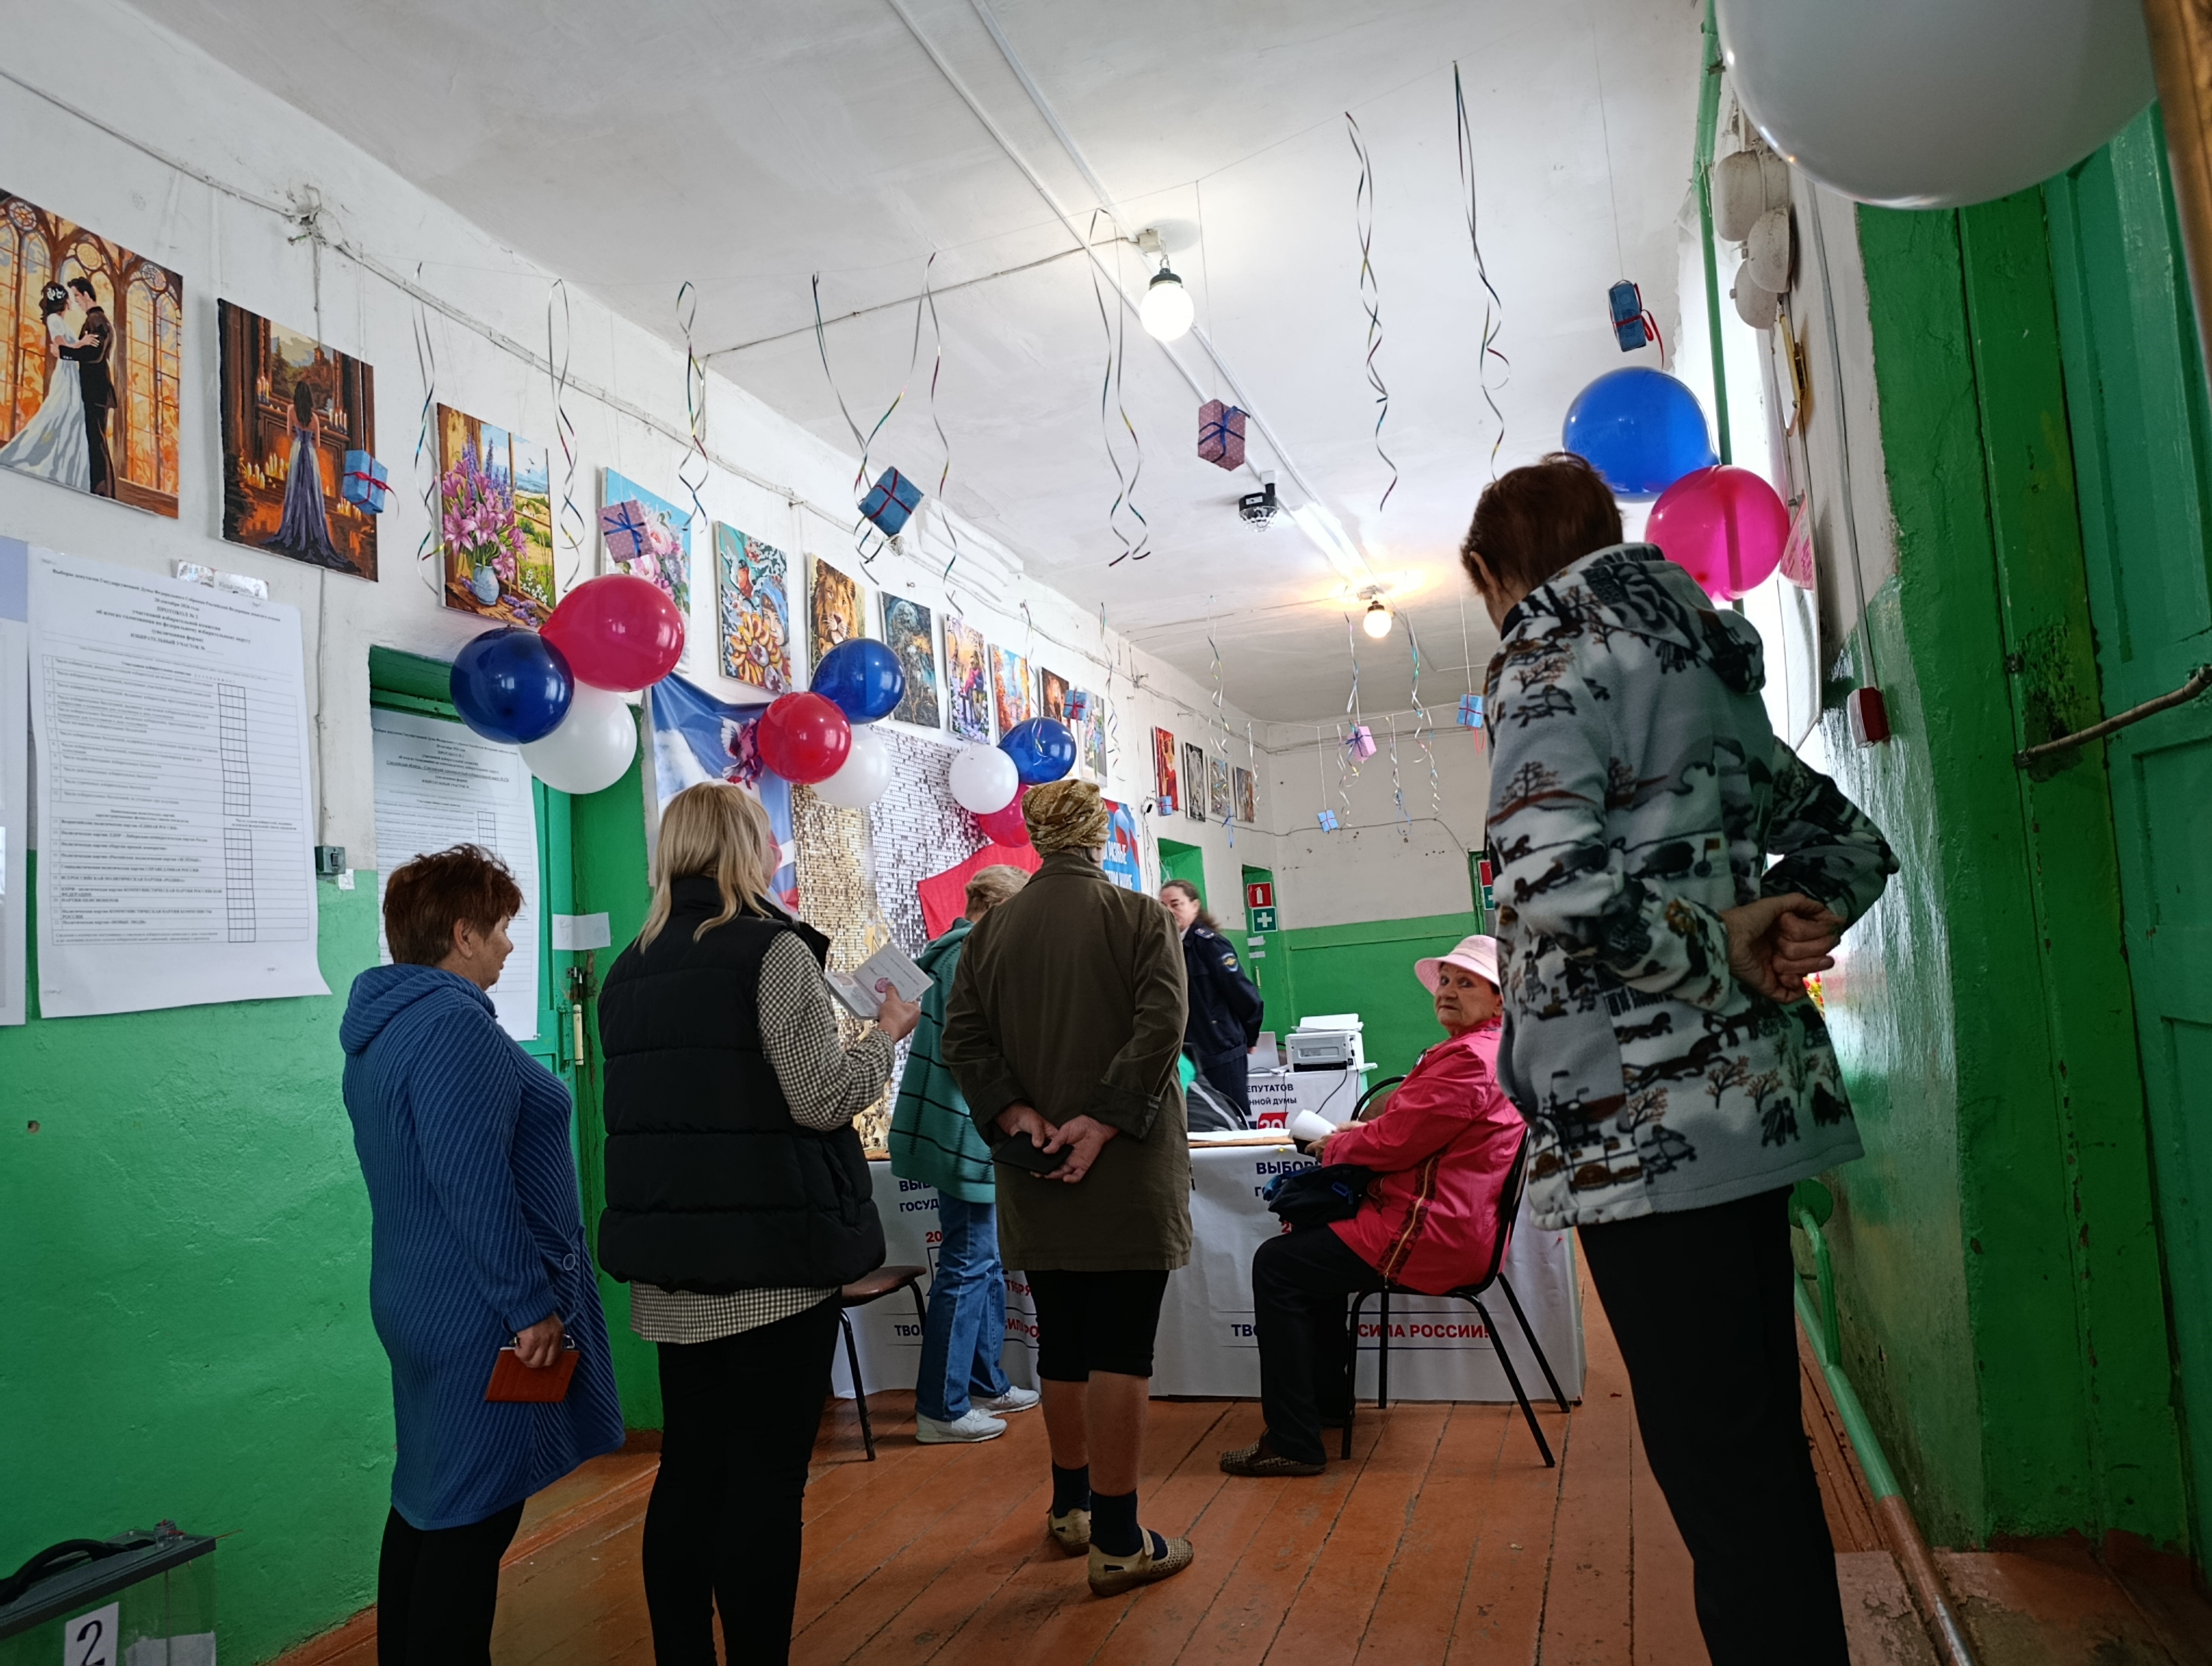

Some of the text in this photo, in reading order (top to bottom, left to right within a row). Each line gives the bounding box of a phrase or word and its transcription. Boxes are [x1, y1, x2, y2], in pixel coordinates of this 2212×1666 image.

[53, 568, 73, 576] Выборы
[75, 574, 99, 582] депутатов
[100, 578, 139, 590] Государственной
[157, 606, 188, 617] ПРОТОКОЛ
[1273, 1097, 1297, 1105] ДУМЫ
[1256, 1161, 1318, 1174] ВЫБО
[1410, 1324, 1489, 1338] РОССИИ!
[77, 1620, 105, 1666] 2
